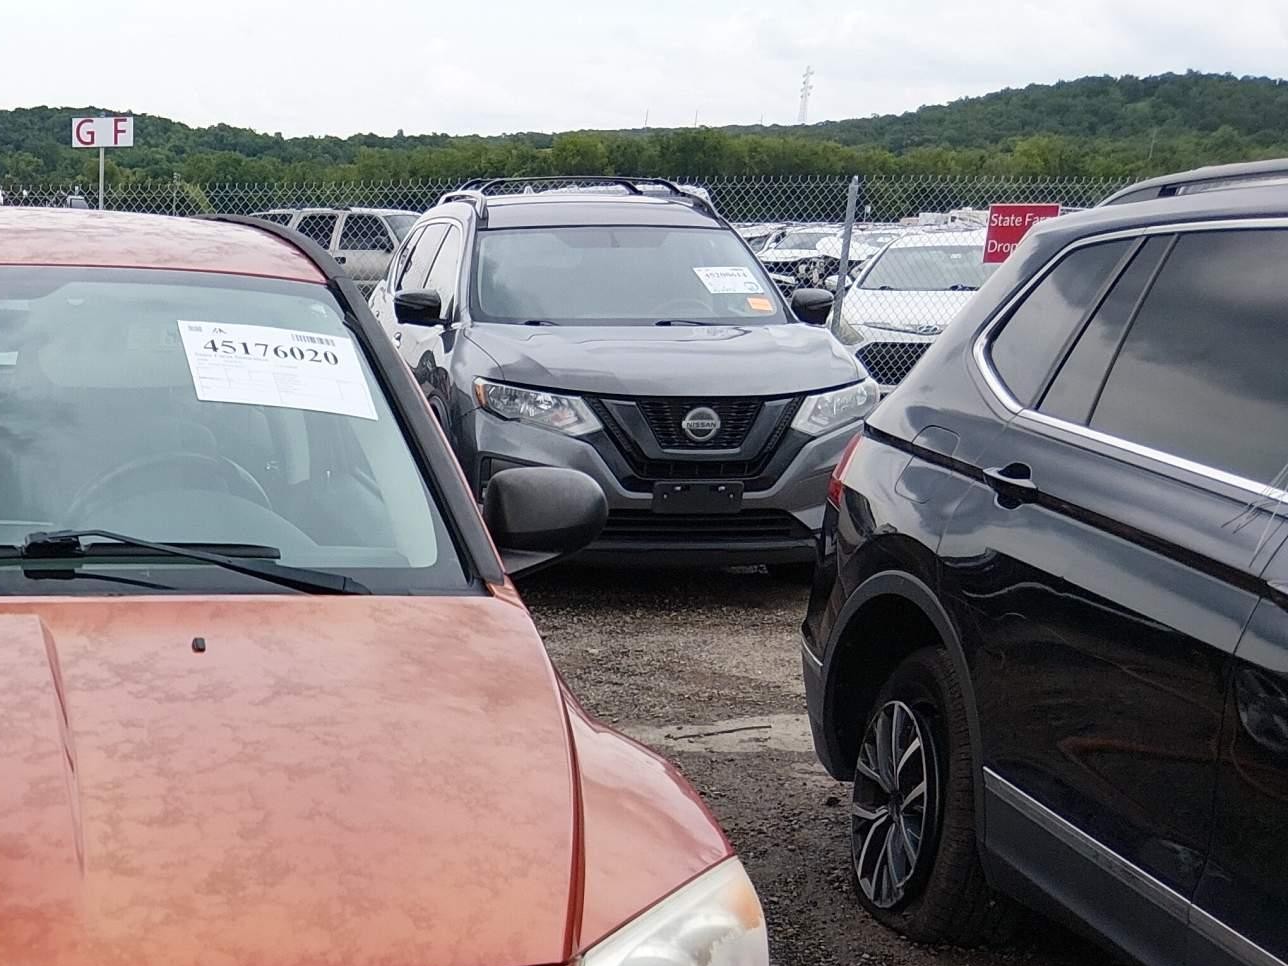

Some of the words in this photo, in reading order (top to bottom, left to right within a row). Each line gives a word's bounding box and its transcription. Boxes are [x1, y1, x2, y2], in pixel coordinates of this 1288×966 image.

[75, 118, 95, 146] G
[113, 118, 128, 146] F
[991, 213, 1023, 227] State
[203, 338, 340, 366] 45176020
[686, 421, 717, 429] NISSAN
